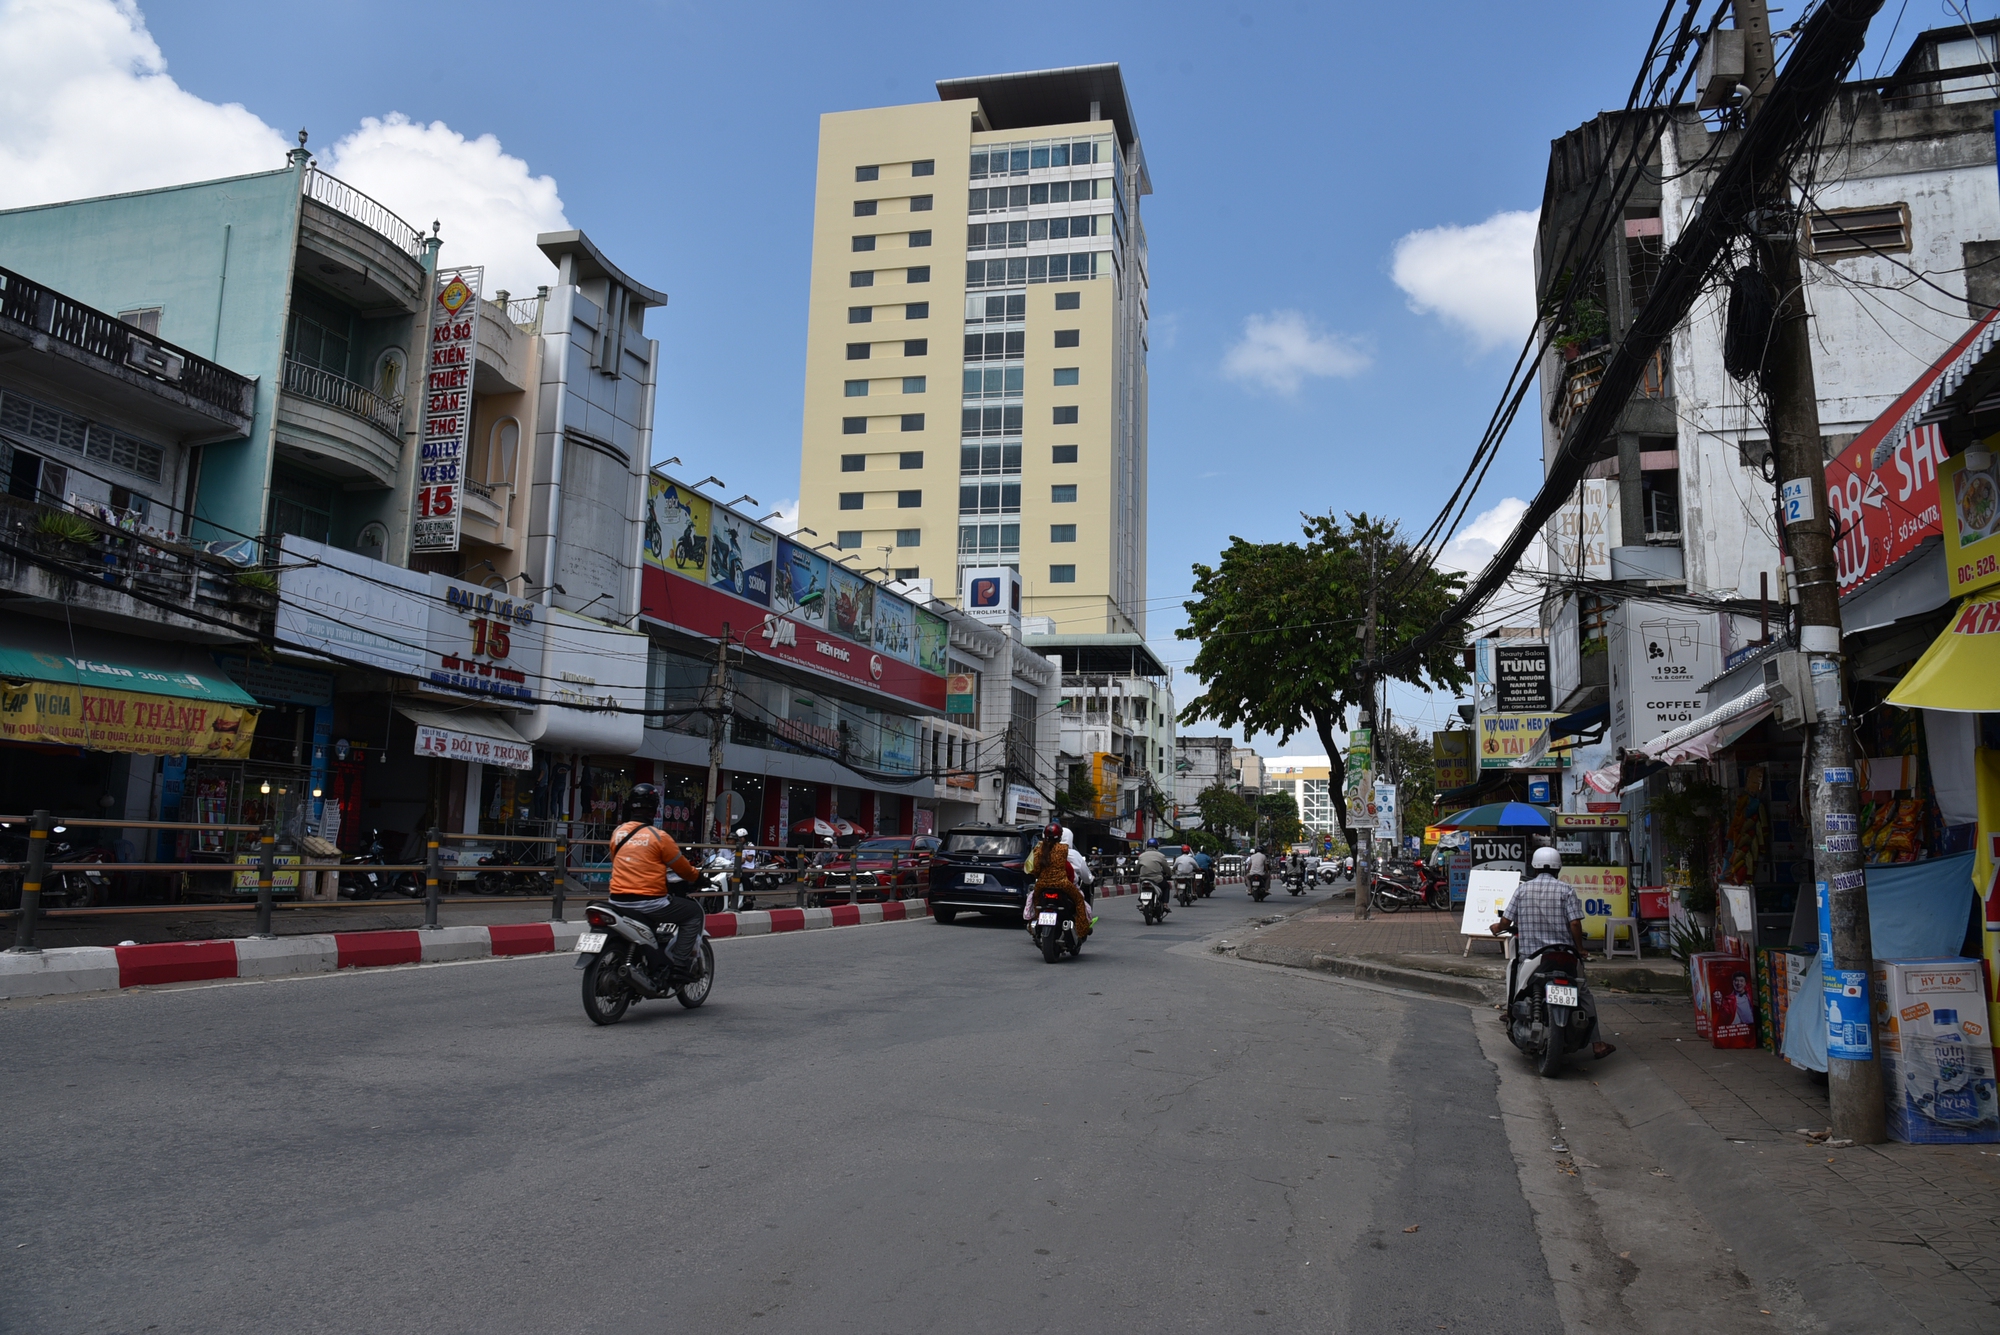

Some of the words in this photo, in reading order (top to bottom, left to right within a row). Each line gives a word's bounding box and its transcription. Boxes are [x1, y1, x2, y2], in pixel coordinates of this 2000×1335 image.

[453, 317, 472, 341] SỐ
[434, 342, 466, 365] KIẾN
[429, 366, 467, 388] THIẾT
[432, 390, 460, 412] CẦN
[429, 415, 458, 435] THƠ
[422, 443, 443, 461] ĐẠI
[445, 436, 460, 457] LÝ
[422, 461, 438, 481] VÉ
[440, 460, 459, 481] SỐ
[418, 486, 453, 517] 15
[1562, 512, 1604, 536] HOA
[1898, 520, 1908, 542] SỐ
[1909, 519, 1919, 535] 54
[1918, 504, 1940, 529] CMT8,
[1563, 542, 1607, 566] MAI
[1957, 568, 1974, 584] ĐC:
[1976, 556, 2000, 579] 52B,
[446, 586, 474, 613] ĐẠI
[475, 592, 493, 615] LÝ
[495, 598, 512, 621] VÉ
[514, 602, 534, 626] SỐ
[308, 623, 325, 637] PHỤC
[326, 626, 335, 638] VỤ
[336, 628, 351, 641] TRỌN
[469, 617, 512, 660] 15
[815, 640, 833, 656] THIÊN
[833, 647, 850, 662] PHÚC
[65, 657, 134, 677] Vistra
[137, 671, 169, 681] 300
[1500, 657, 1546, 672] TÙNG
[1657, 666, 1688, 674] 1932
[2, 693, 28, 717] LẠP
[34, 693, 46, 718] VỊ
[49, 695, 71, 716] GIA
[79, 696, 127, 726] KIM
[133, 700, 208, 733] THÀNH
[1646, 700, 1702, 709] COFFEE
[1498, 718, 1519, 732] QUAY
[1527, 718, 1542, 731] HEO
[1657, 710, 1692, 722] MUỐI
[3, 723, 16, 736] VỊT
[90, 729, 105, 740] HEO
[776, 716, 811, 742] THIÊN
[812, 723, 841, 748] PHÚC
[421, 737, 447, 752] 15
[451, 735, 472, 753] ĐỔI
[475, 741, 490, 756] VÉ
[494, 745, 529, 761] TRÚNG
[1502, 734, 1527, 755] TÀI
[1437, 779, 1452, 788] TÀI
[1563, 816, 1596, 825] Cam
[1599, 815, 1619, 827] Ép
[627, 837, 649, 847] Food
[1473, 839, 1522, 859] TÙNG
[1602, 869, 1626, 895] ÉP
[1585, 898, 1612, 916] 0k
[1921, 977, 1935, 986] HY
[1941, 976, 1962, 986] LẠP
[1548, 994, 1576, 1006] 558.87
[1965, 1022, 1981, 1034] MỚI
[1935, 1044, 1964, 1058] nutri
[1940, 1098, 1953, 1108] HY
